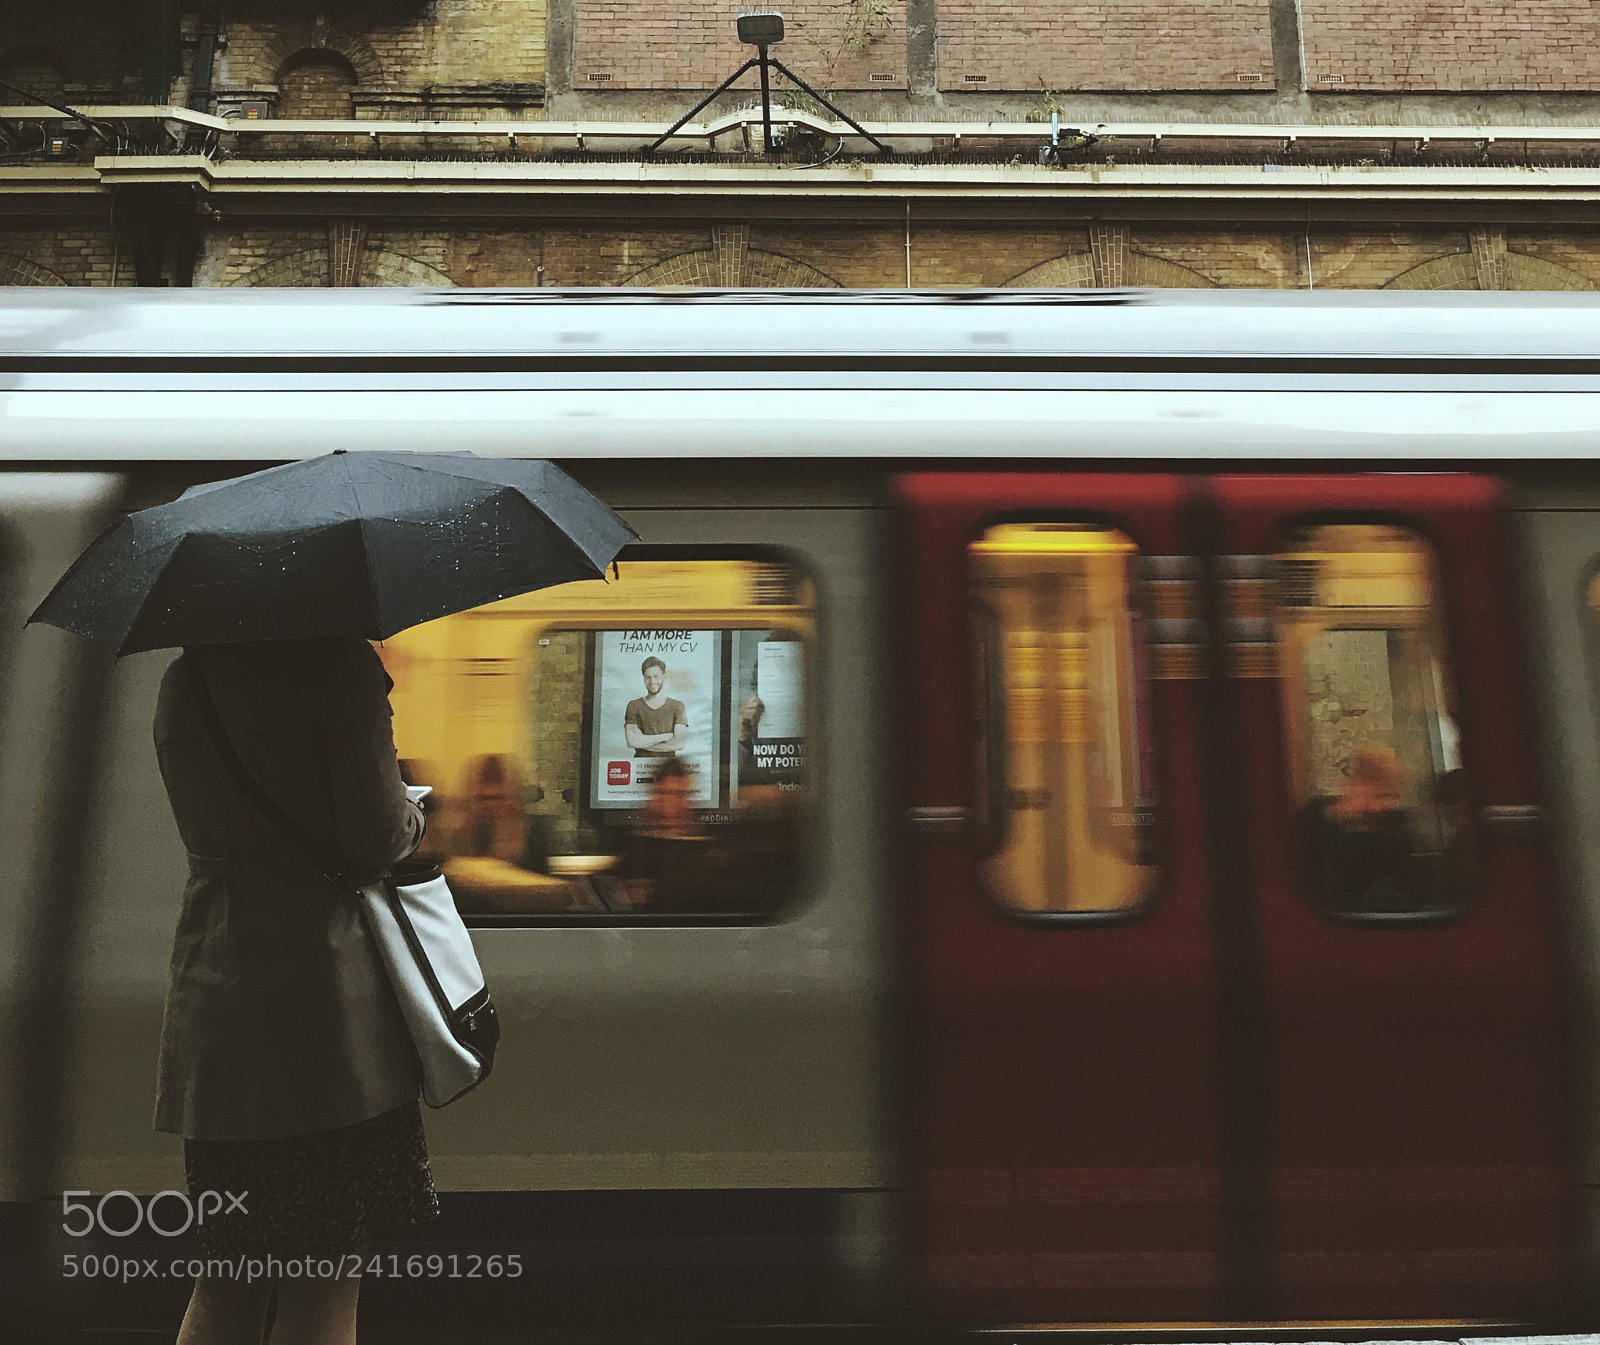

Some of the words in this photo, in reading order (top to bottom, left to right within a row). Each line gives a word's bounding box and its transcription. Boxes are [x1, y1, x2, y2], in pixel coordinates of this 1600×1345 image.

[630, 630, 651, 640] AM
[654, 630, 692, 640] MORE
[619, 643, 654, 653] THAN
[657, 643, 677, 653] MY
[680, 642, 698, 652] CV
[753, 745, 778, 755] NOW
[780, 745, 795, 755] DO
[757, 757, 773, 768] MY
